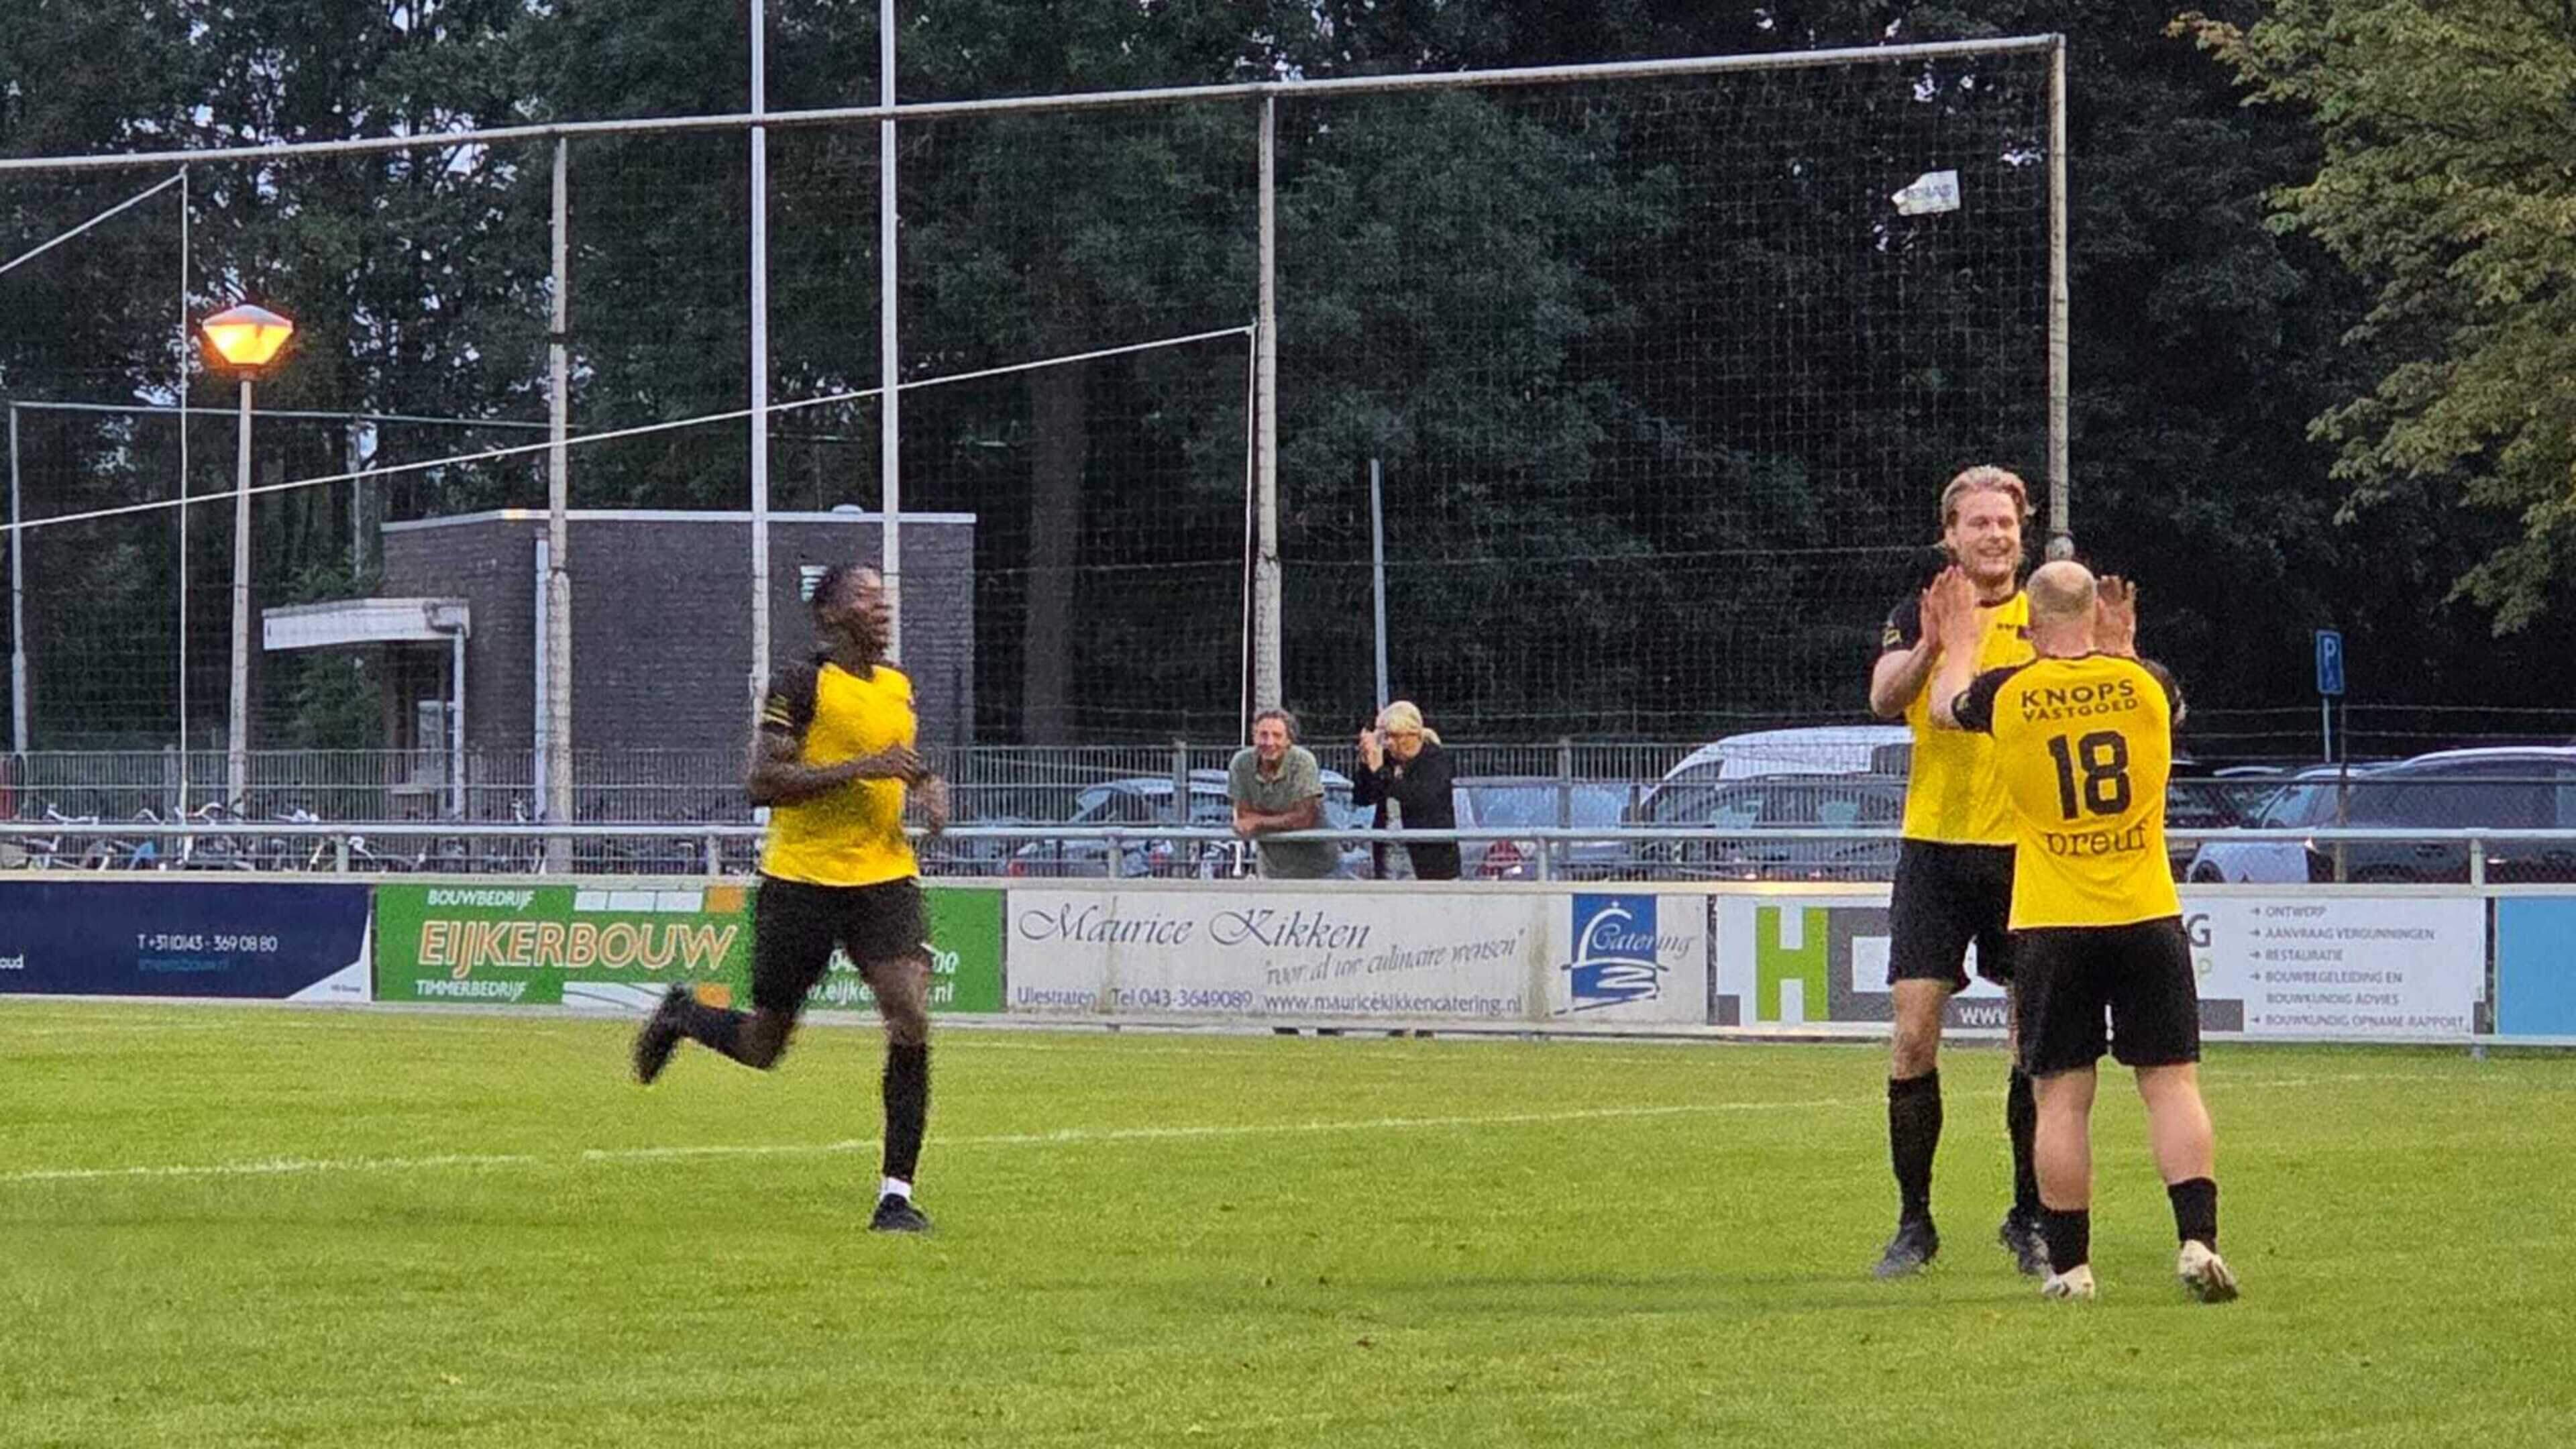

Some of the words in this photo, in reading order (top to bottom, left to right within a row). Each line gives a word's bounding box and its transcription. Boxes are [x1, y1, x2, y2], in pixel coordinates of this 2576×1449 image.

[2323, 637, 2337, 669] P
[2021, 679, 2135, 708] KNOPS
[2023, 698, 2138, 722] VASTGOED
[2048, 731, 2131, 820] 18
[427, 890, 534, 911] BOUWBEDRIJF
[2265, 906, 2326, 918] ONTWERP
[1018, 902, 1193, 945] Maurice
[1209, 908, 1371, 948] Kikken
[2265, 927, 2334, 940] AANVRAAG
[2336, 928, 2435, 940] VERGUNNINGEN
[137, 933, 146, 950] T
[213, 934, 237, 952] 369
[242, 935, 260, 952] 08
[262, 936, 278, 953] 80
[419, 920, 738, 979] EIJKERBOUW
[1593, 924, 1697, 959] Catering
[2265, 949, 2343, 961] RESTAURATIE
[2265, 971, 2383, 983] BOUWBEGELEIDING
[2385, 971, 2403, 983] EN
[415, 980, 527, 1002] TIMMERBEDRIJF
[1017, 986, 1096, 1006] Ulestraten
[1111, 987, 1136, 1006] Tel
[1139, 989, 1254, 1008] 043-3649089
[1264, 993, 1523, 1016] www.mauricekikkencatering.nl
[2266, 993, 2353, 1006] BOUWKUNDIG
[2355, 993, 2400, 1006] ADVIES
[2265, 1014, 2349, 1026] BOUWKUNDIG
[2352, 1015, 2405, 1027] OPNAME
[2408, 1016, 2465, 1028] RAPPORT
